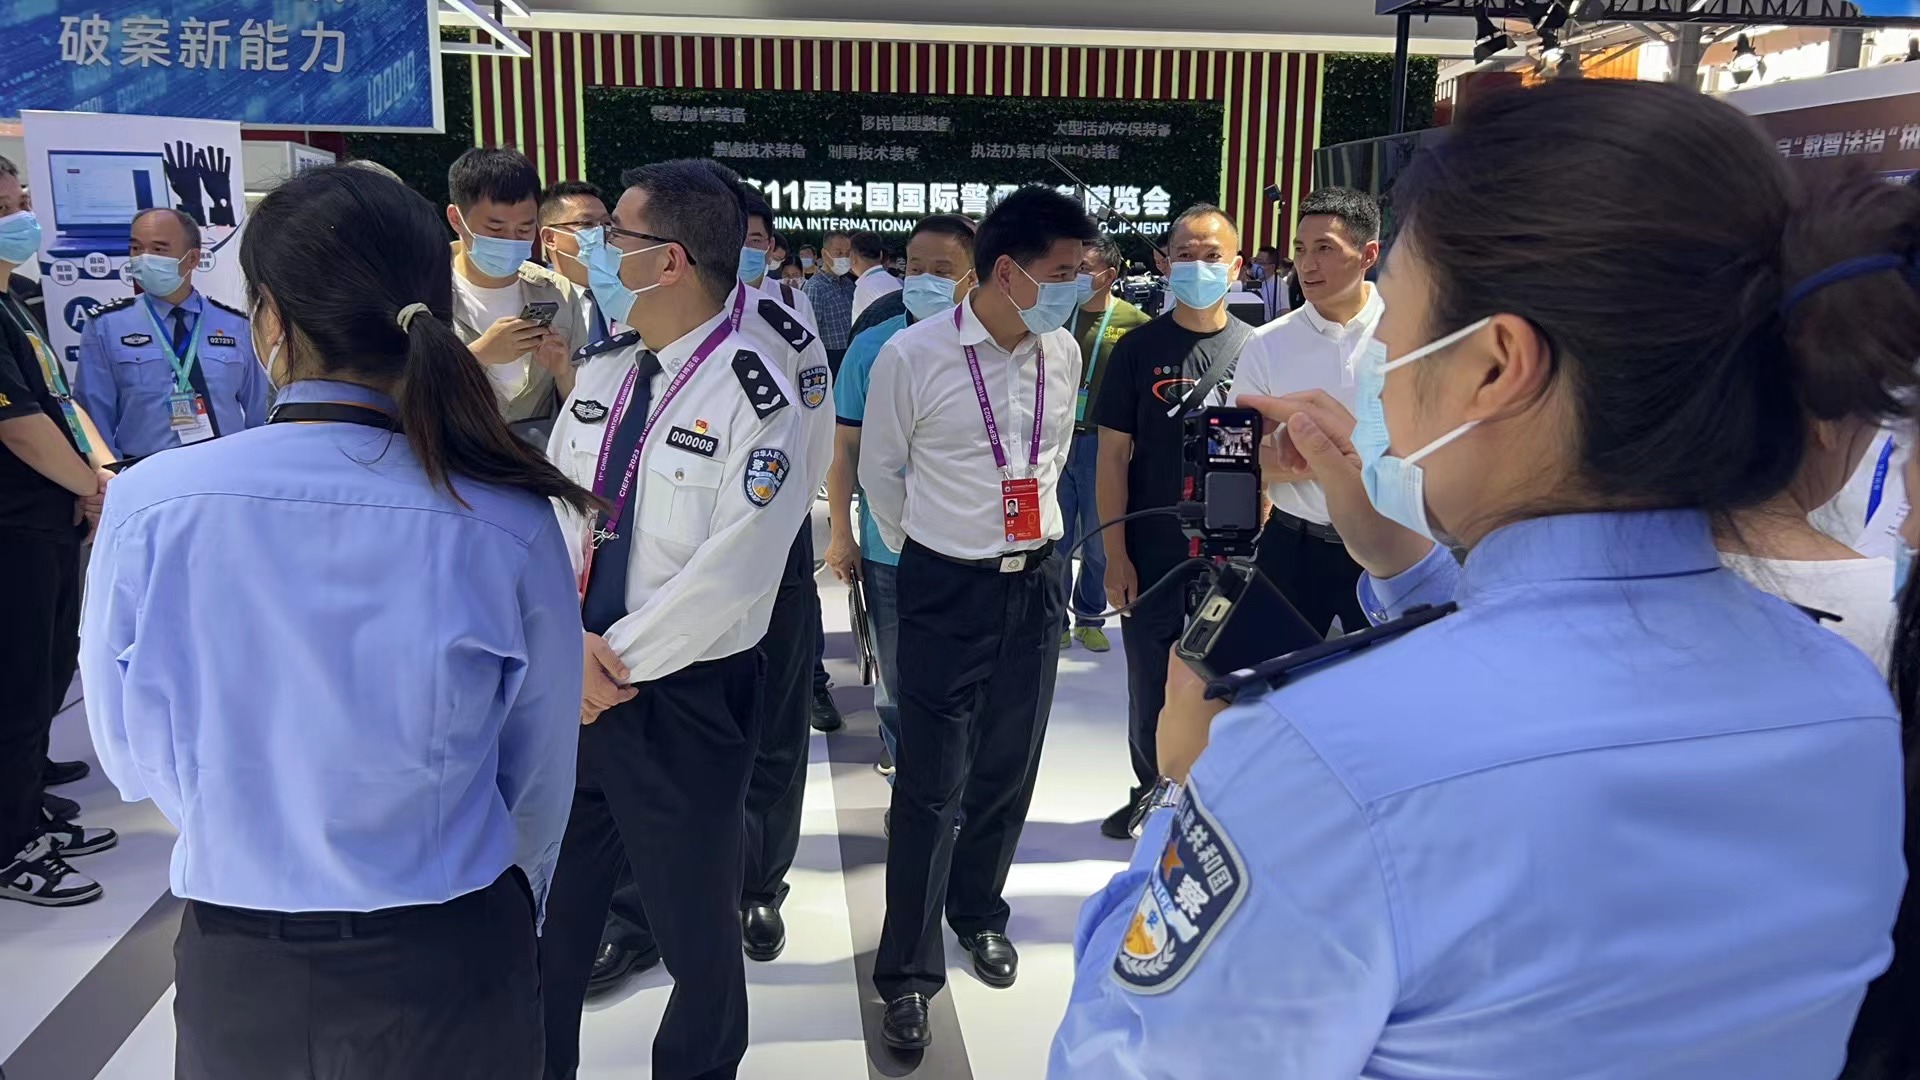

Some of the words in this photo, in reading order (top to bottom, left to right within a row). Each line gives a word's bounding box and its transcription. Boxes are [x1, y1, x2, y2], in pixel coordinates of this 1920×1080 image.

[58, 15, 347, 73] 破案新能力
[746, 178, 1172, 217] 11届中国国际警博览会
[772, 216, 802, 230] HINA
[618, 374, 634, 407] EXHIBITION
[604, 406, 623, 452] INTERNATIONAL
[983, 406, 993, 425] 2023
[671, 431, 714, 452] 000008
[987, 425, 999, 446] CIEPE
[600, 452, 610, 472] CHINA
[619, 470, 633, 497] CIEPE
[628, 449, 641, 470] 2023
